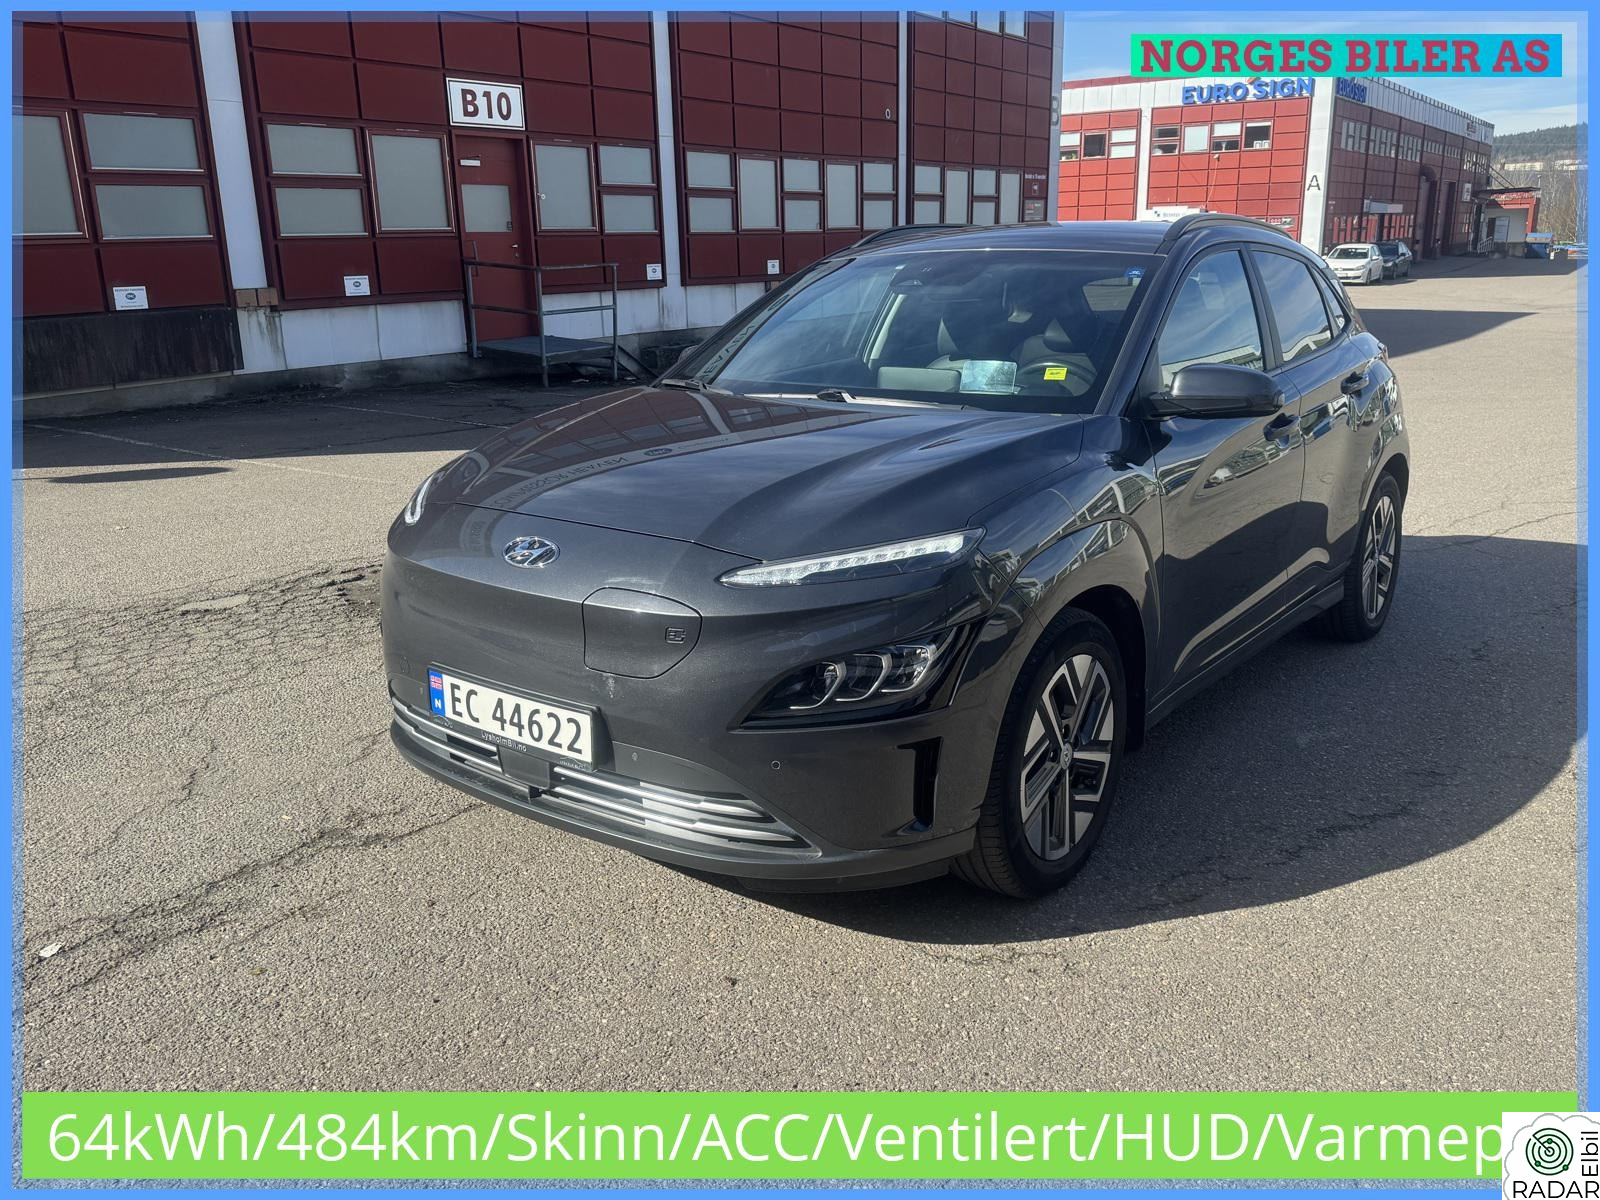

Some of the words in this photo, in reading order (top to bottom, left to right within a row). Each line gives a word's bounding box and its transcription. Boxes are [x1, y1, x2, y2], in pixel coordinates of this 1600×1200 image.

[461, 88, 512, 121] B10
[1181, 82, 1249, 105] EURO
[1252, 77, 1316, 100] SIGN
[1307, 174, 1321, 191] A
[434, 698, 442, 709] N
[450, 683, 480, 723] EC
[491, 697, 583, 755] 44622
